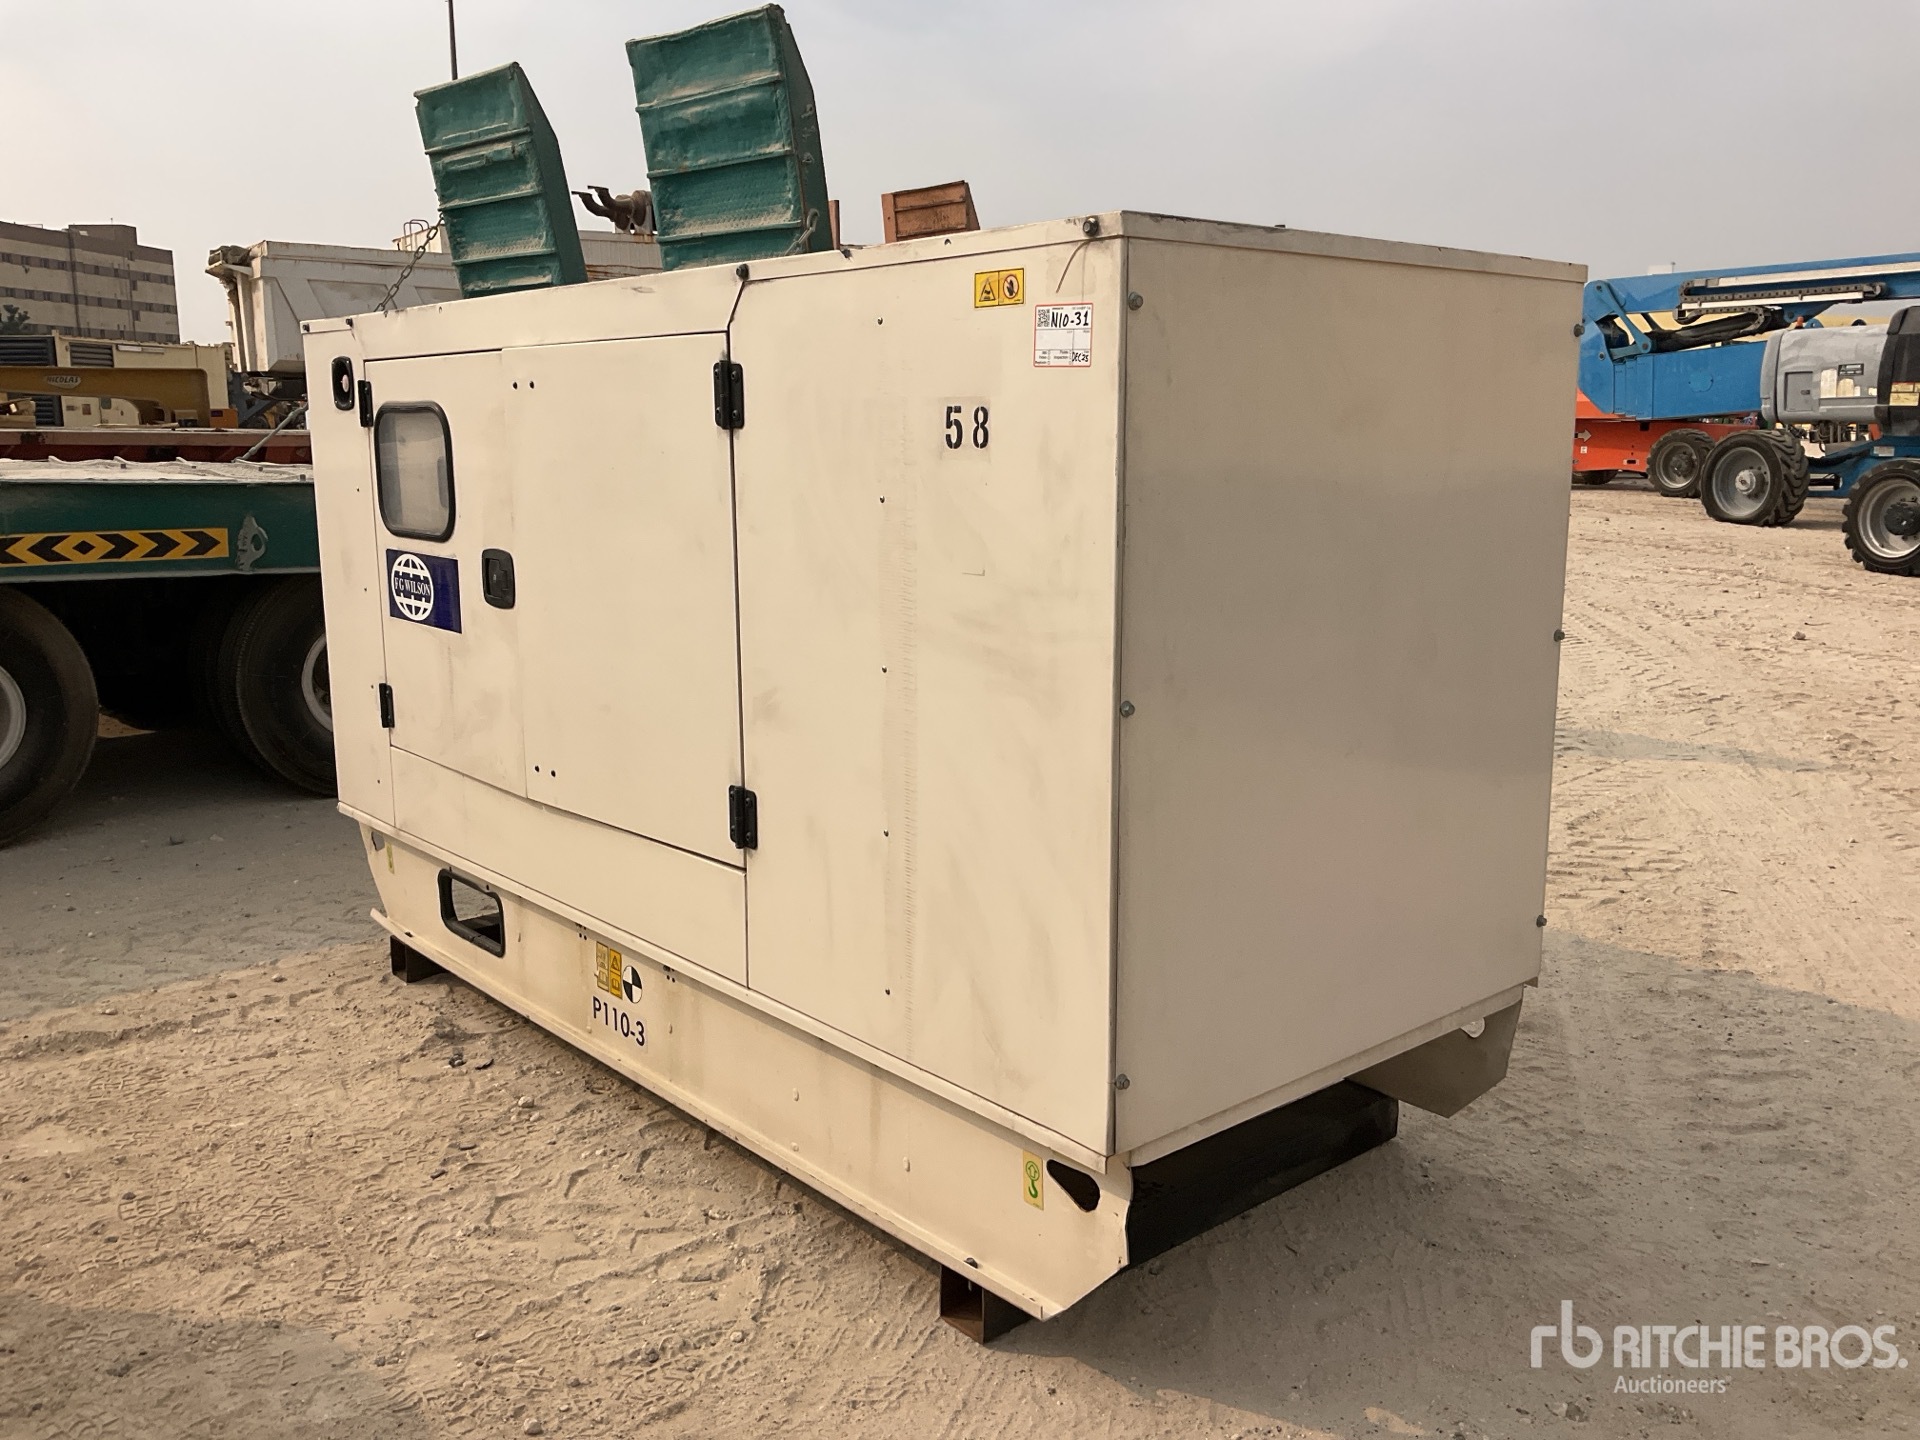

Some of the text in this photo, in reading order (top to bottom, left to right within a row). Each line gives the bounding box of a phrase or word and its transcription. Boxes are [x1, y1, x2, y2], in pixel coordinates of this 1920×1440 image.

[47, 376, 79, 384] NICOLAS
[404, 578, 431, 596] WILSON
[593, 996, 645, 1046] P110-3
